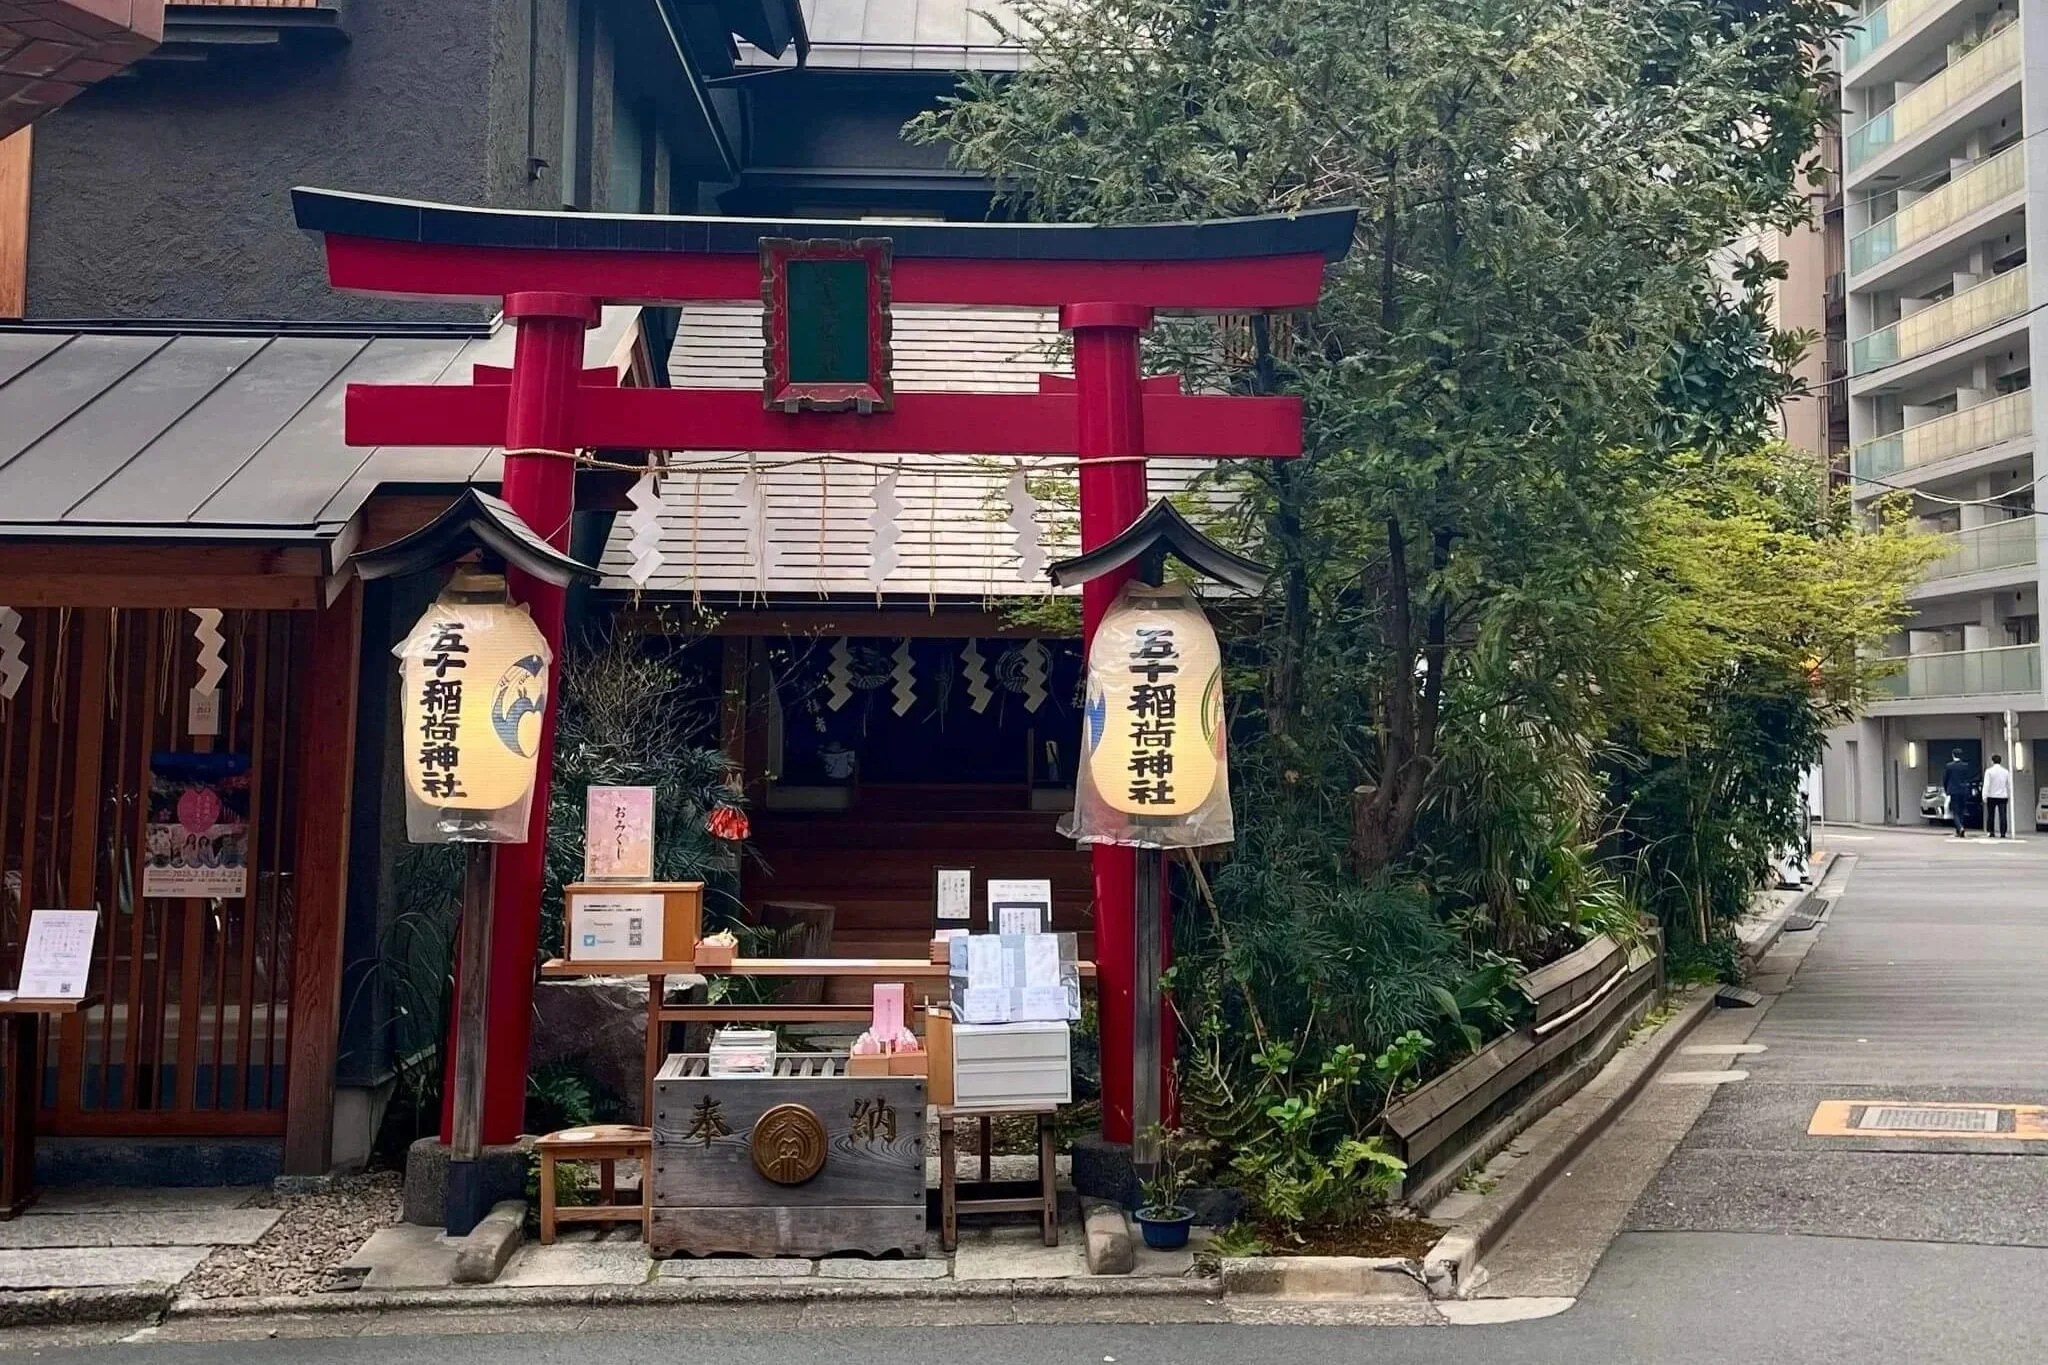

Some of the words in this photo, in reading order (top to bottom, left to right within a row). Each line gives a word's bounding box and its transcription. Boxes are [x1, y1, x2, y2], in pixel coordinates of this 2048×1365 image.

[419, 622, 470, 798] 五十稲荷神社
[1127, 629, 1180, 804] 五十稲荷神社
[614, 806, 626, 861] おみくじ
[683, 1094, 733, 1149] 奉
[848, 1096, 897, 1145] 納
